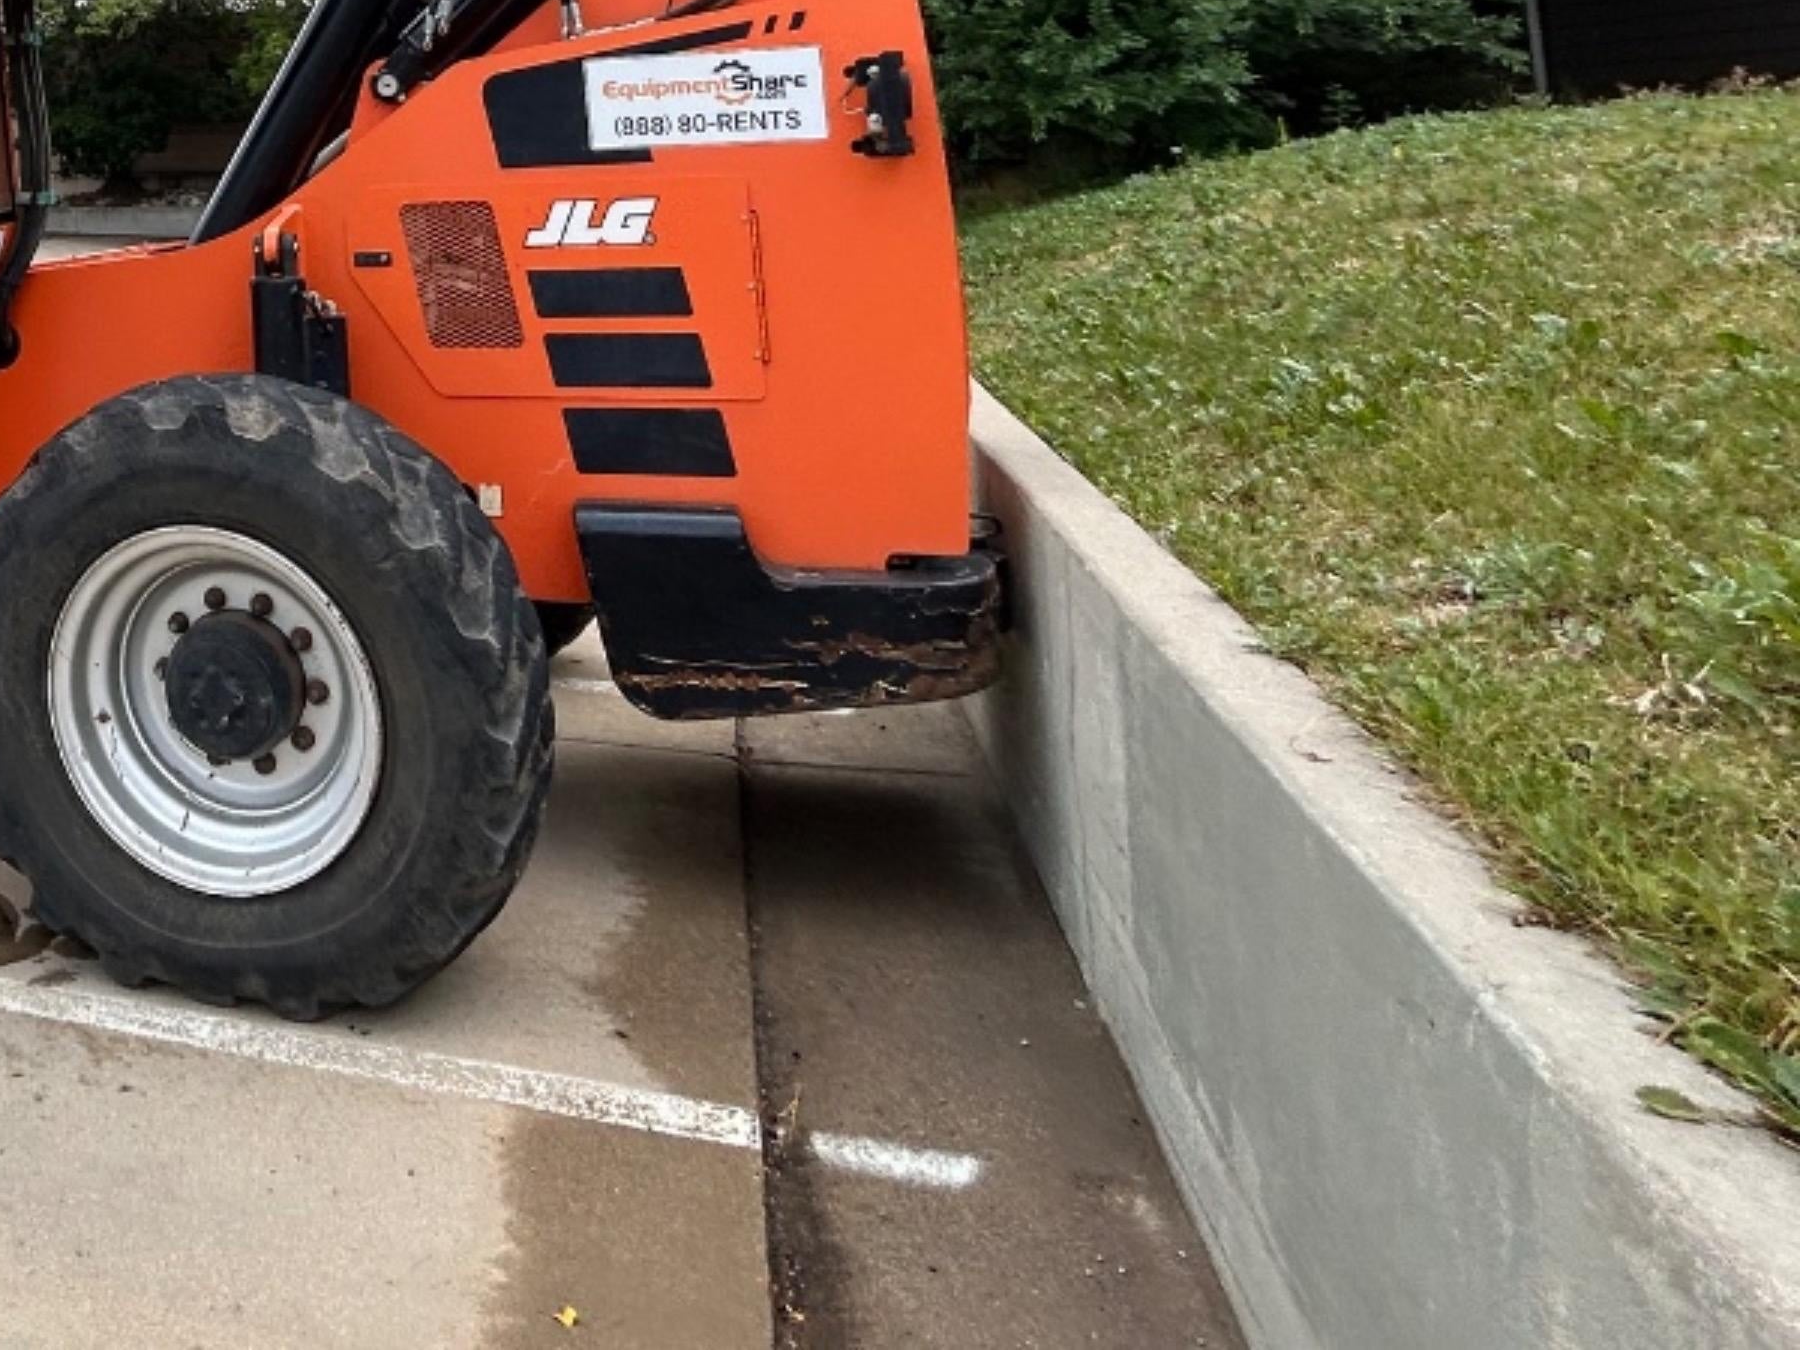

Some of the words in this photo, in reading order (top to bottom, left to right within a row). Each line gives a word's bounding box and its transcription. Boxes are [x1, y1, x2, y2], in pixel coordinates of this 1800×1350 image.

[614, 114, 673, 138] (888)
[677, 109, 802, 134] 80-RENTS
[522, 195, 660, 248] JLG
